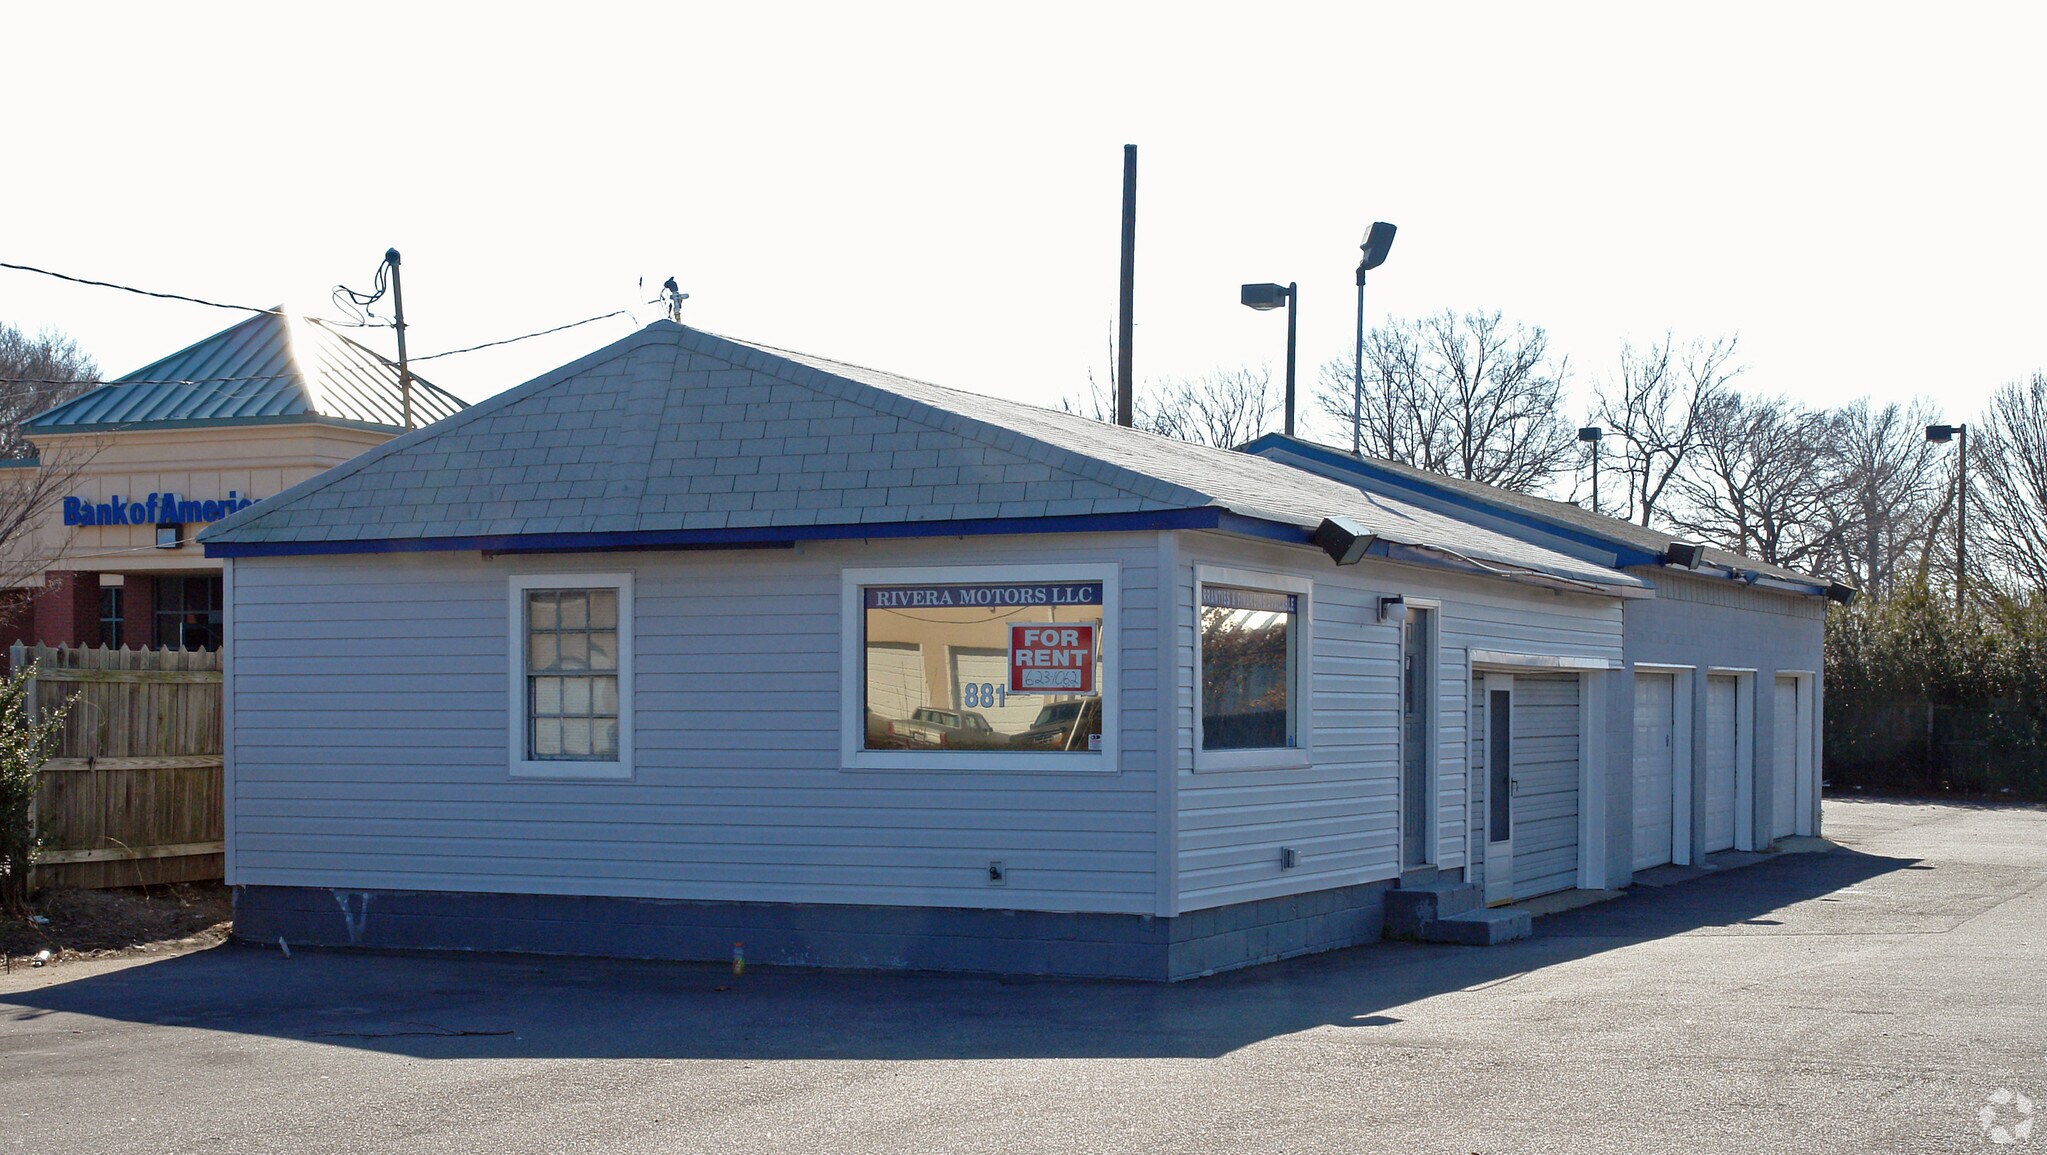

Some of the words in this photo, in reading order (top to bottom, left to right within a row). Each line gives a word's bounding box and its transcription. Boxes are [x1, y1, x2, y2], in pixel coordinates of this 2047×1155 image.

[64, 495, 127, 526] Bank
[130, 492, 158, 523] of
[876, 590, 953, 607] RIVERA
[959, 588, 1046, 605] MOTORS
[1052, 587, 1093, 603] LLC
[1024, 629, 1079, 647] FOR
[1015, 649, 1088, 667] RENT
[964, 682, 1005, 708] 881
